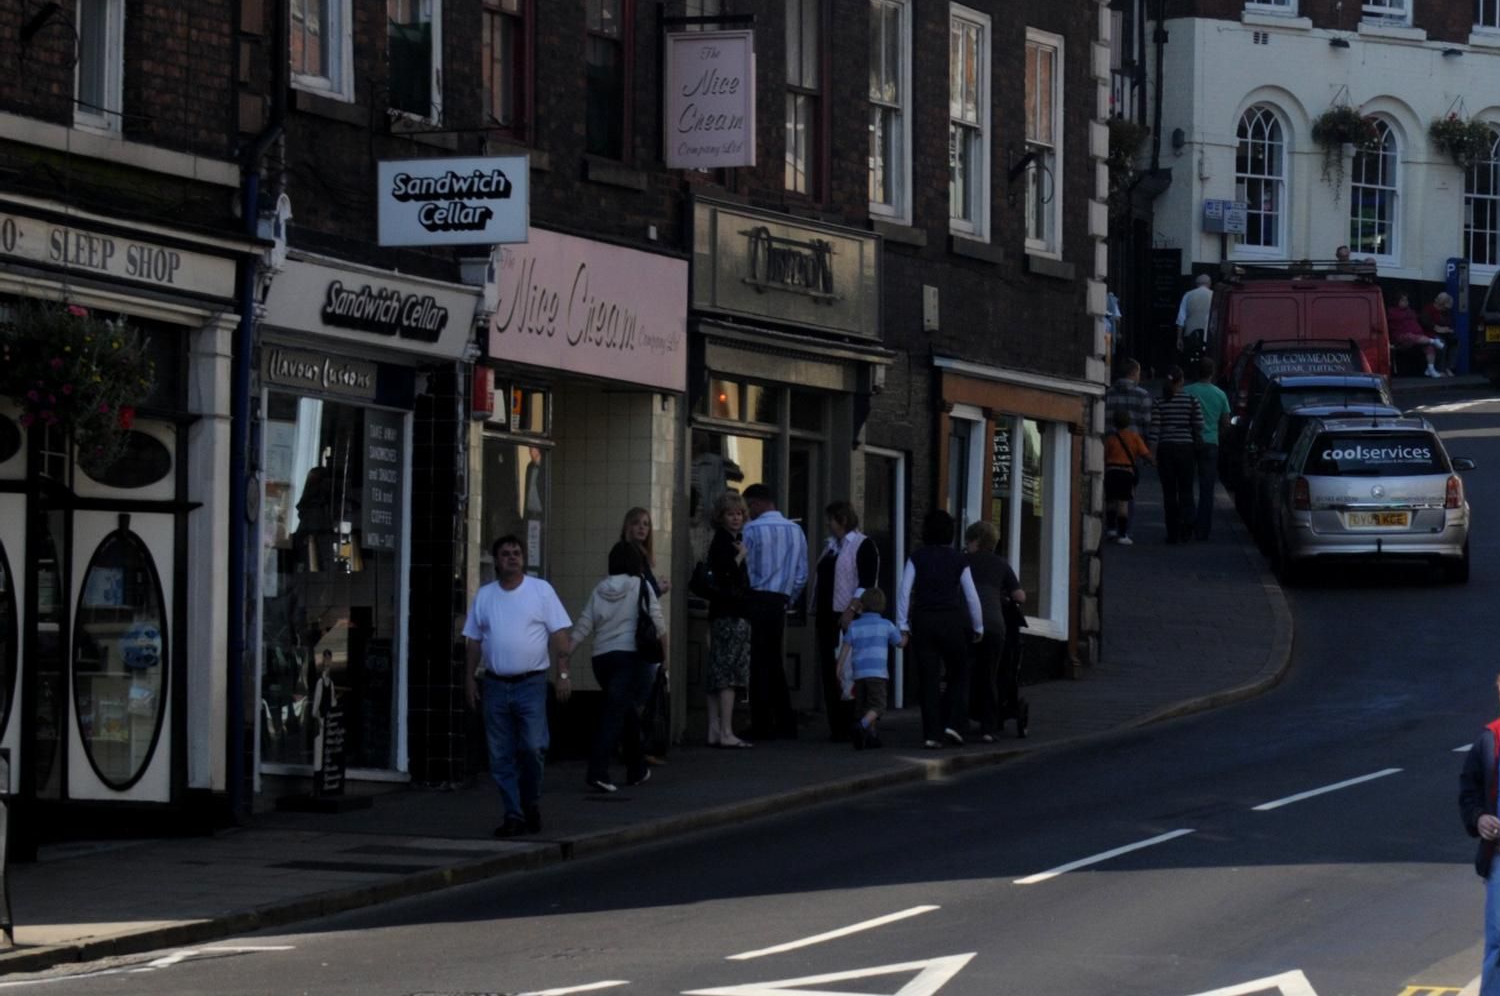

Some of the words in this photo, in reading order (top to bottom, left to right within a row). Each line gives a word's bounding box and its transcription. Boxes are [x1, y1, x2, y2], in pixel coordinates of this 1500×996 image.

[682, 68, 740, 97] Nice
[677, 103, 744, 133] Cream
[392, 170, 508, 199] Sandwich
[418, 203, 490, 230] Cellar
[50, 227, 115, 270] SLEEP
[126, 244, 181, 283] SHOP
[323, 281, 400, 329] Sandwich
[401, 294, 447, 336] Cellar
[496, 256, 560, 337] Nice
[1322, 445, 1432, 460] coolservices
